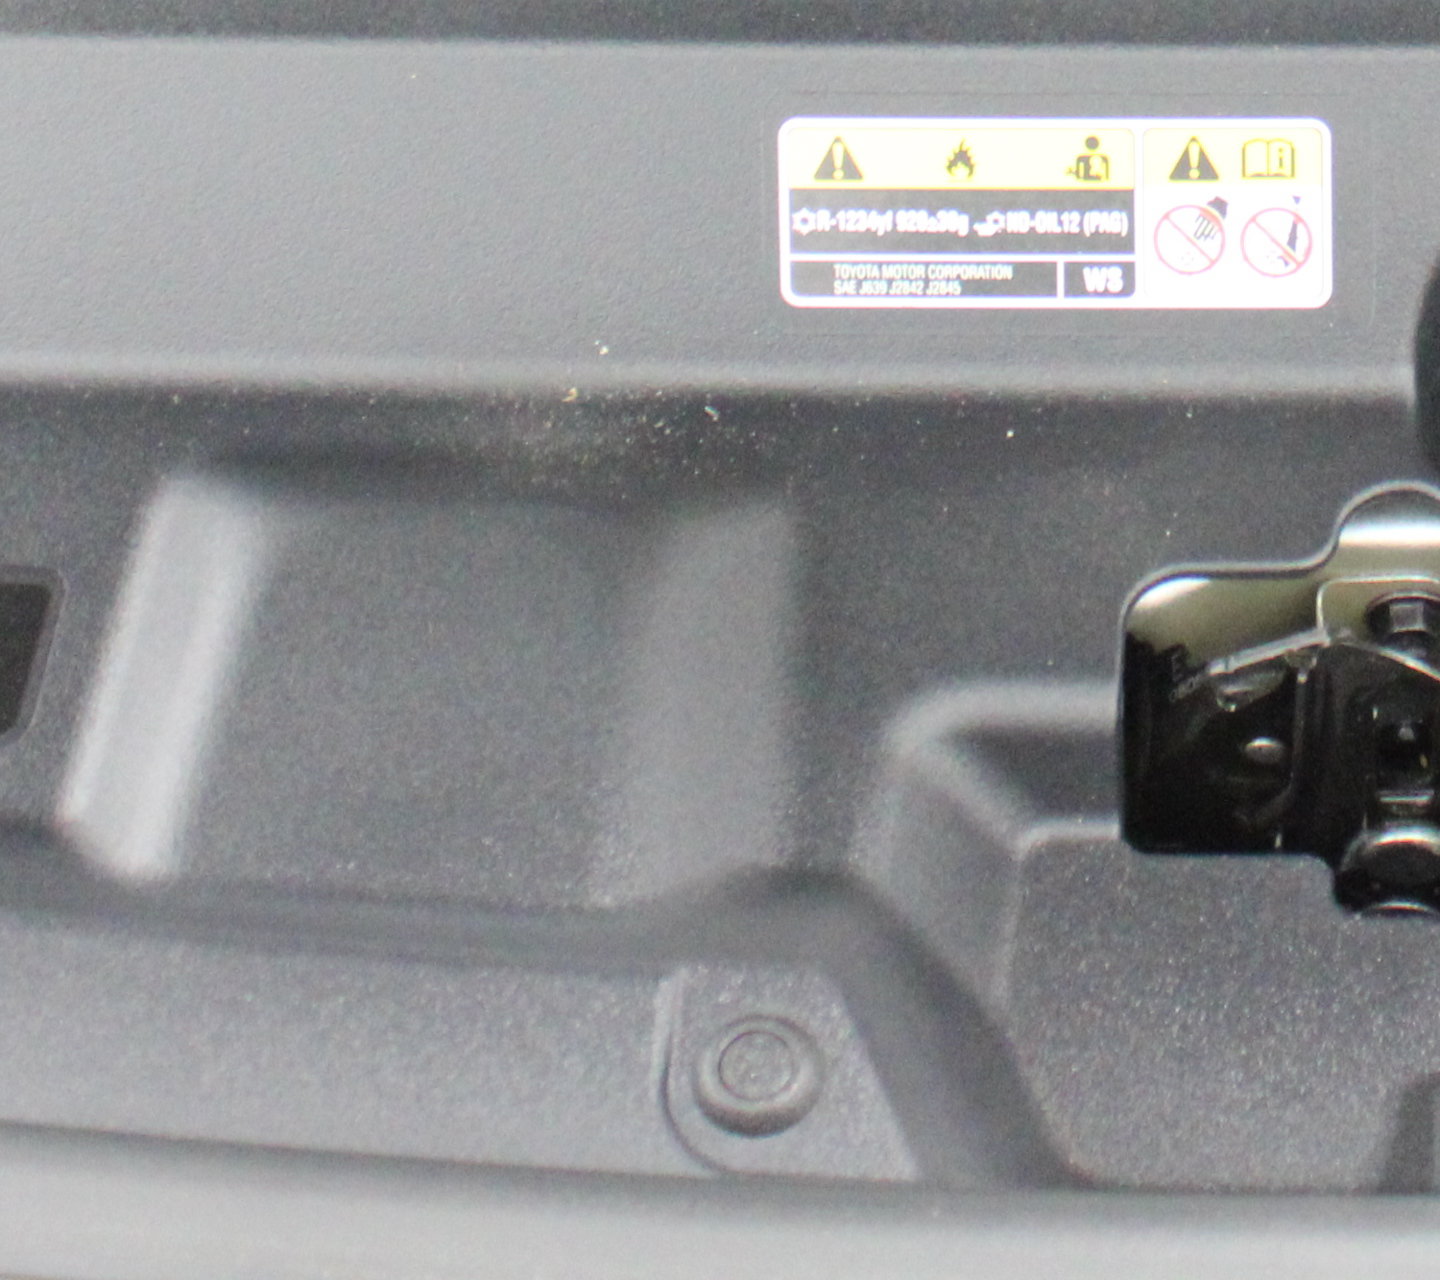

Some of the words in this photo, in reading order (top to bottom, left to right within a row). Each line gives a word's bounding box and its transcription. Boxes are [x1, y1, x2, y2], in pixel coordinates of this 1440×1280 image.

[816, 208, 894, 236] R-1234yf
[833, 263, 881, 280] TOYOTA
[881, 263, 926, 281] MOTOR
[927, 264, 1014, 281] CORPORATION
[1082, 264, 1125, 294] WS
[833, 280, 858, 296] SAE
